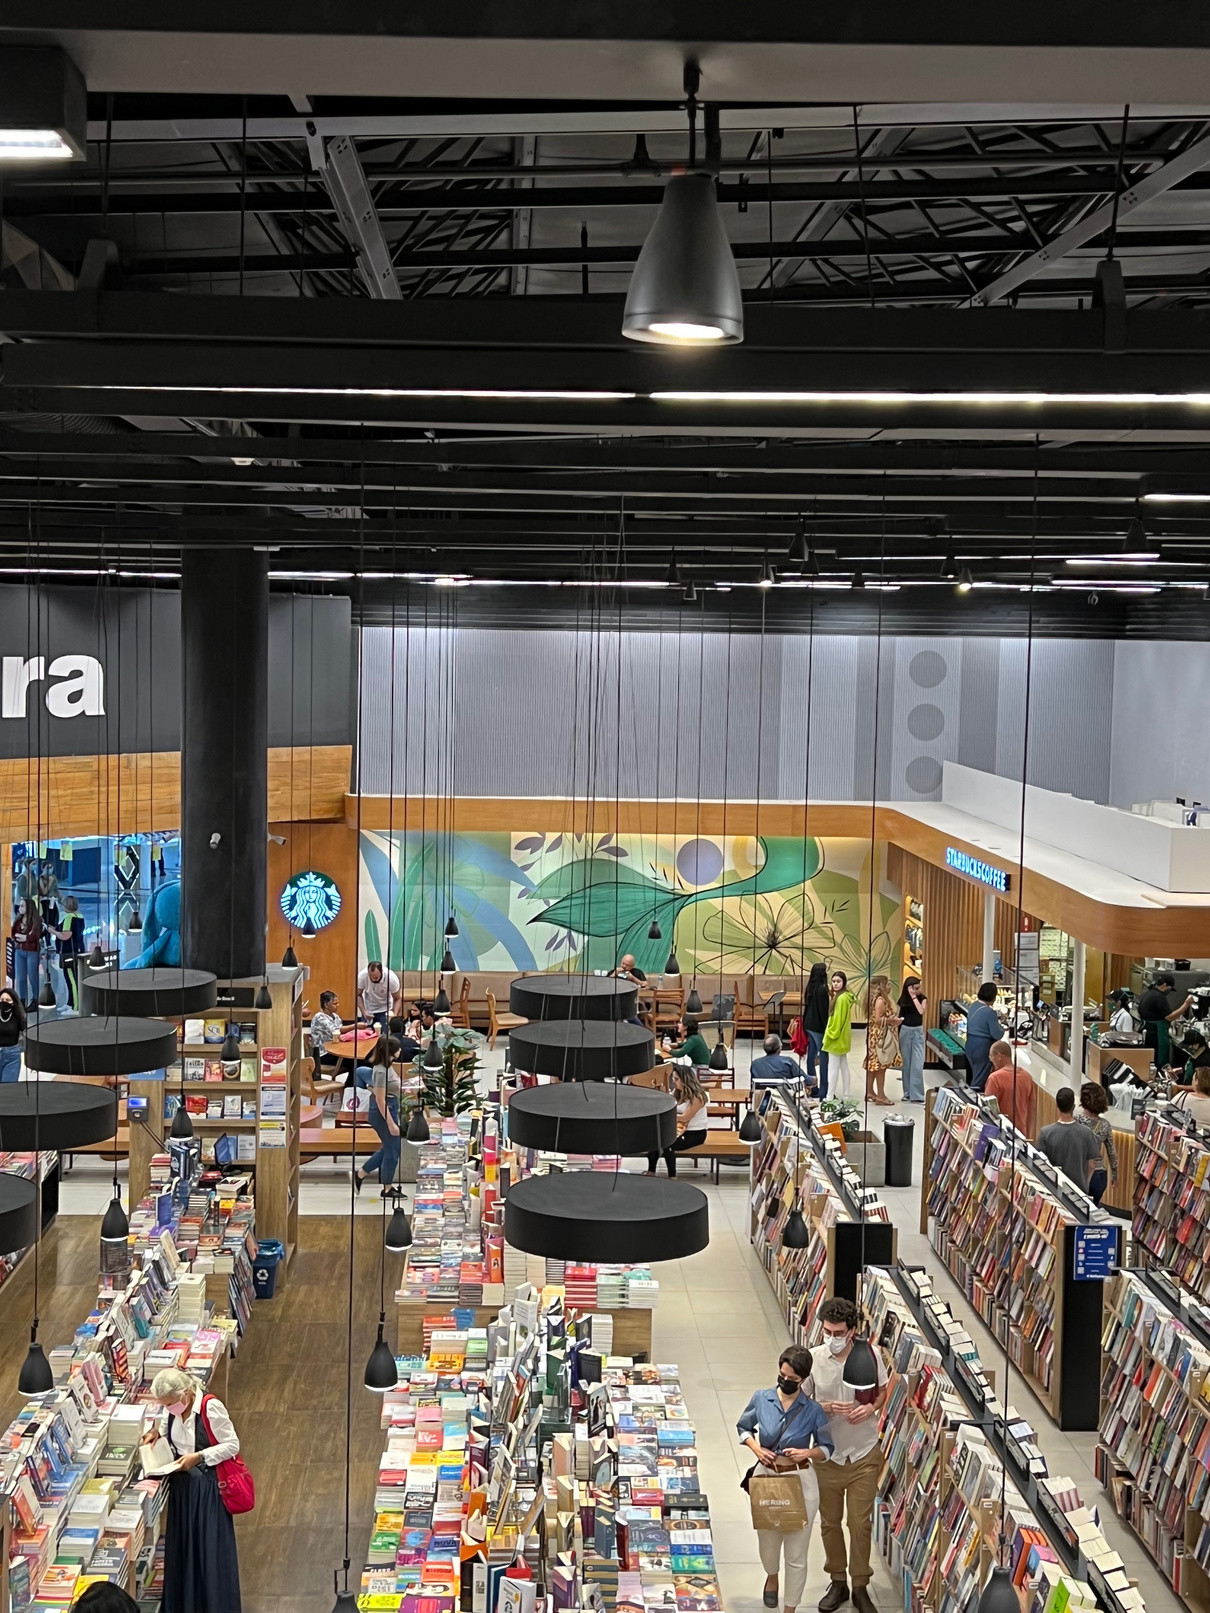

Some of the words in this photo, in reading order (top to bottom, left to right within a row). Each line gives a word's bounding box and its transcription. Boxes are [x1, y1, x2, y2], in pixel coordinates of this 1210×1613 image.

[1, 654, 106, 719] ra
[946, 846, 982, 879] STARBUCKS
[981, 863, 1006, 892] COFFEE
